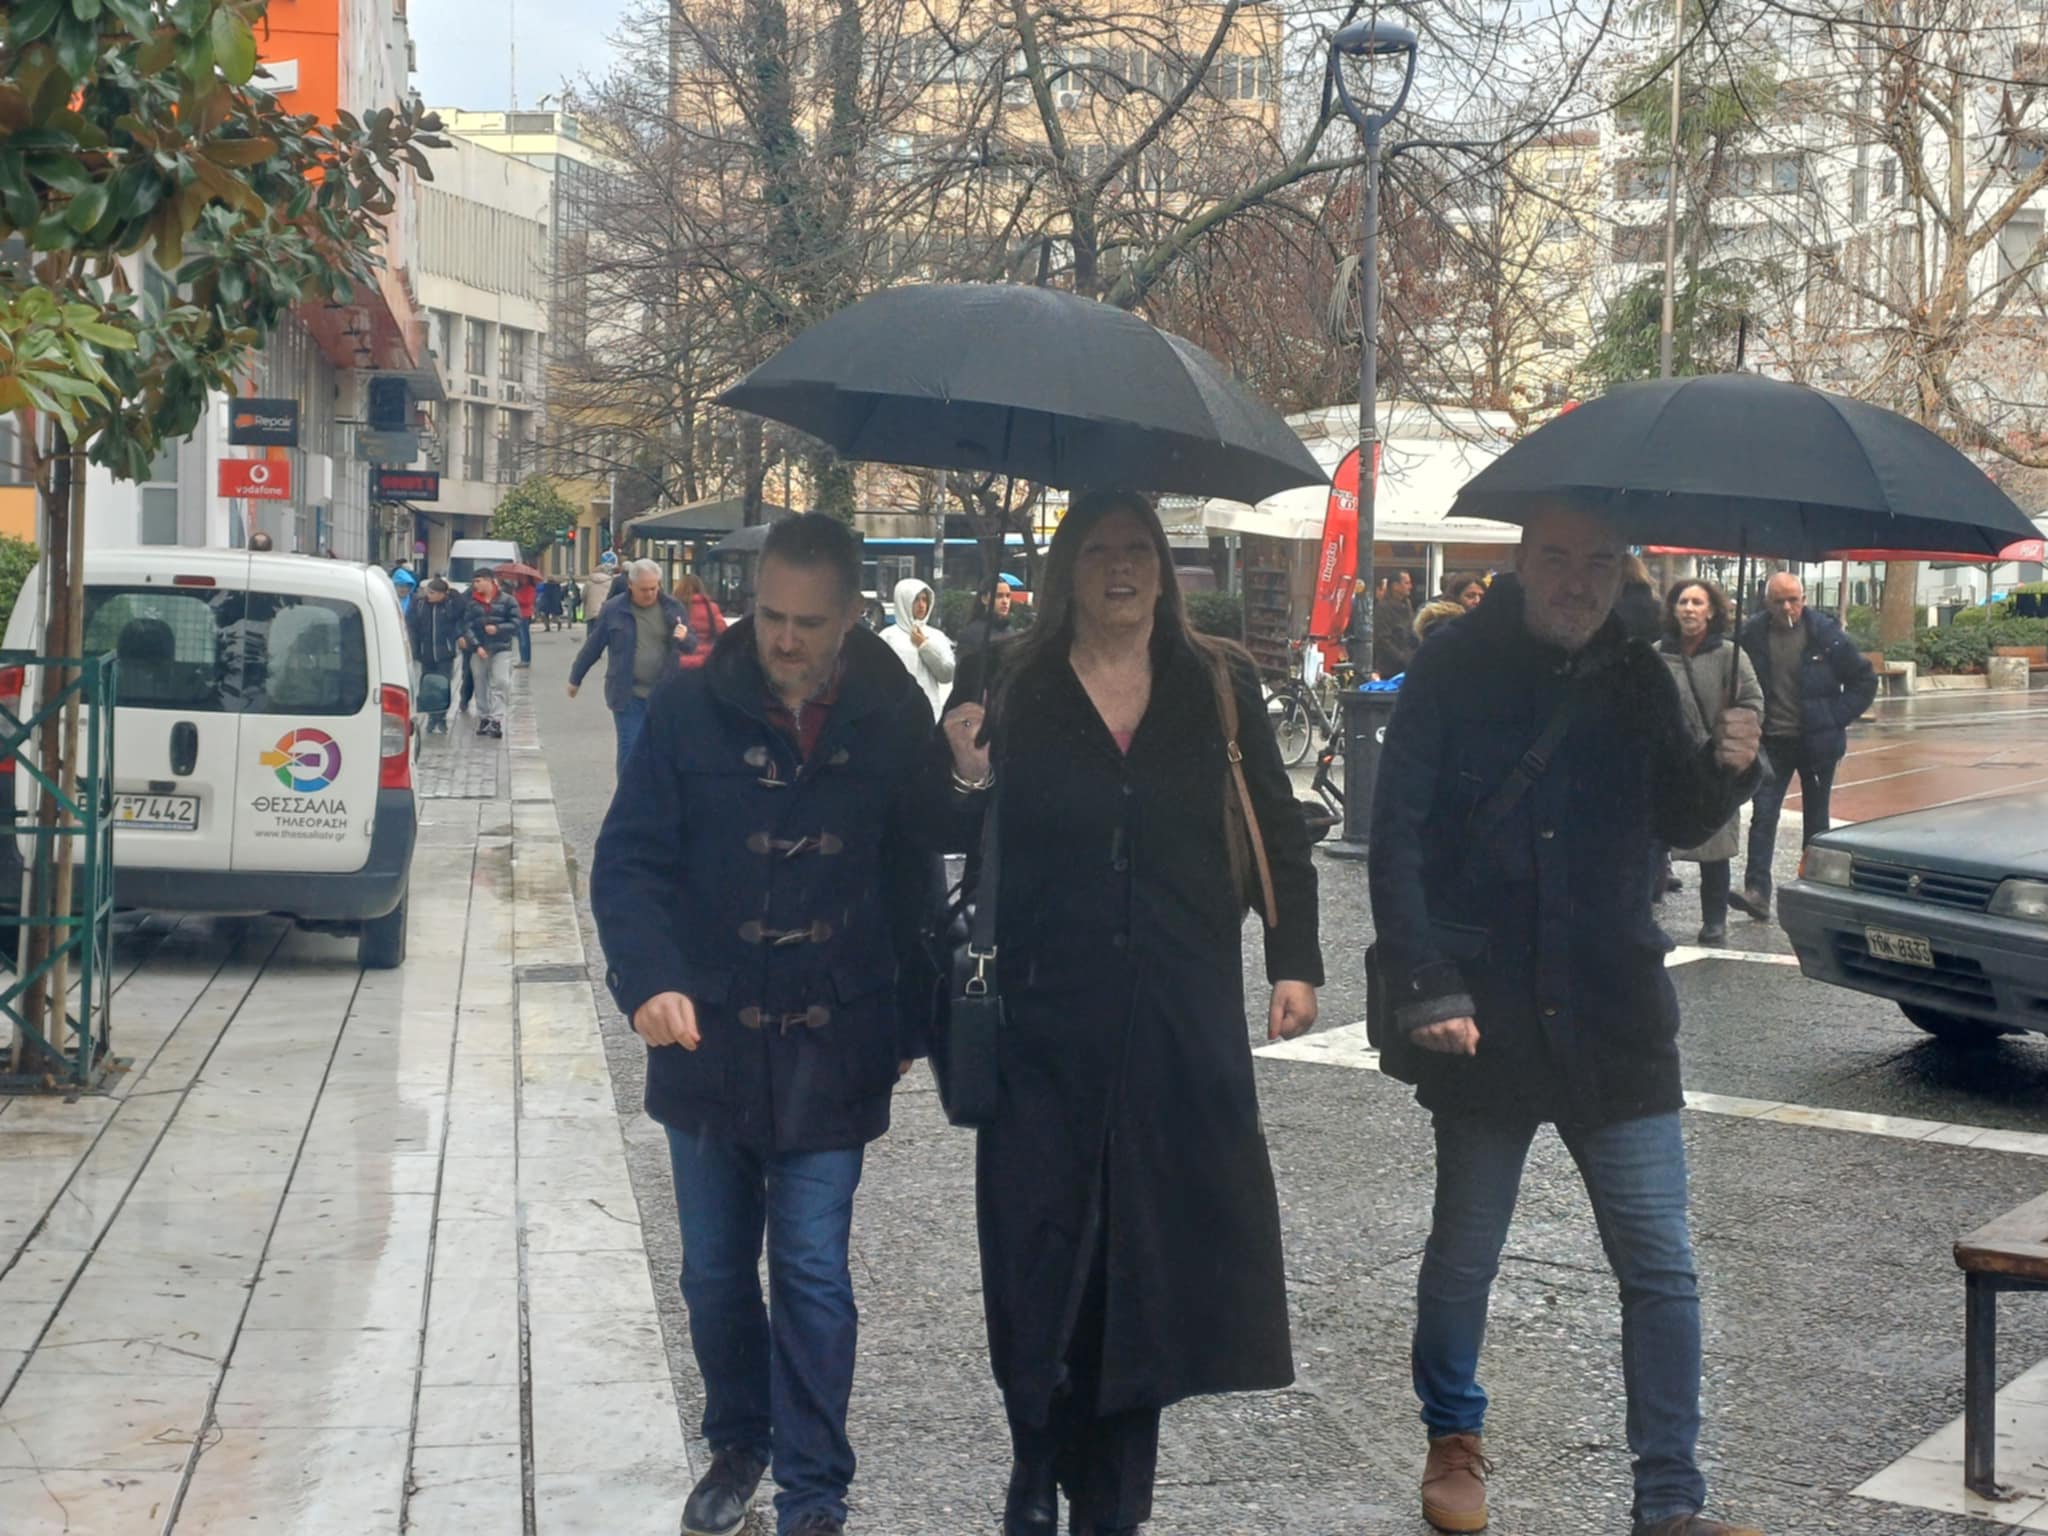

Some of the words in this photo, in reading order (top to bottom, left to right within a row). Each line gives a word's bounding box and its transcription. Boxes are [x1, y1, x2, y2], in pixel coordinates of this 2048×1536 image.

[235, 485, 282, 495] vodafone
[251, 796, 347, 815] ΘΕΣΣΑΛΙΑ
[275, 816, 347, 829] ΤΗΛΕΟΡΑΣΗ
